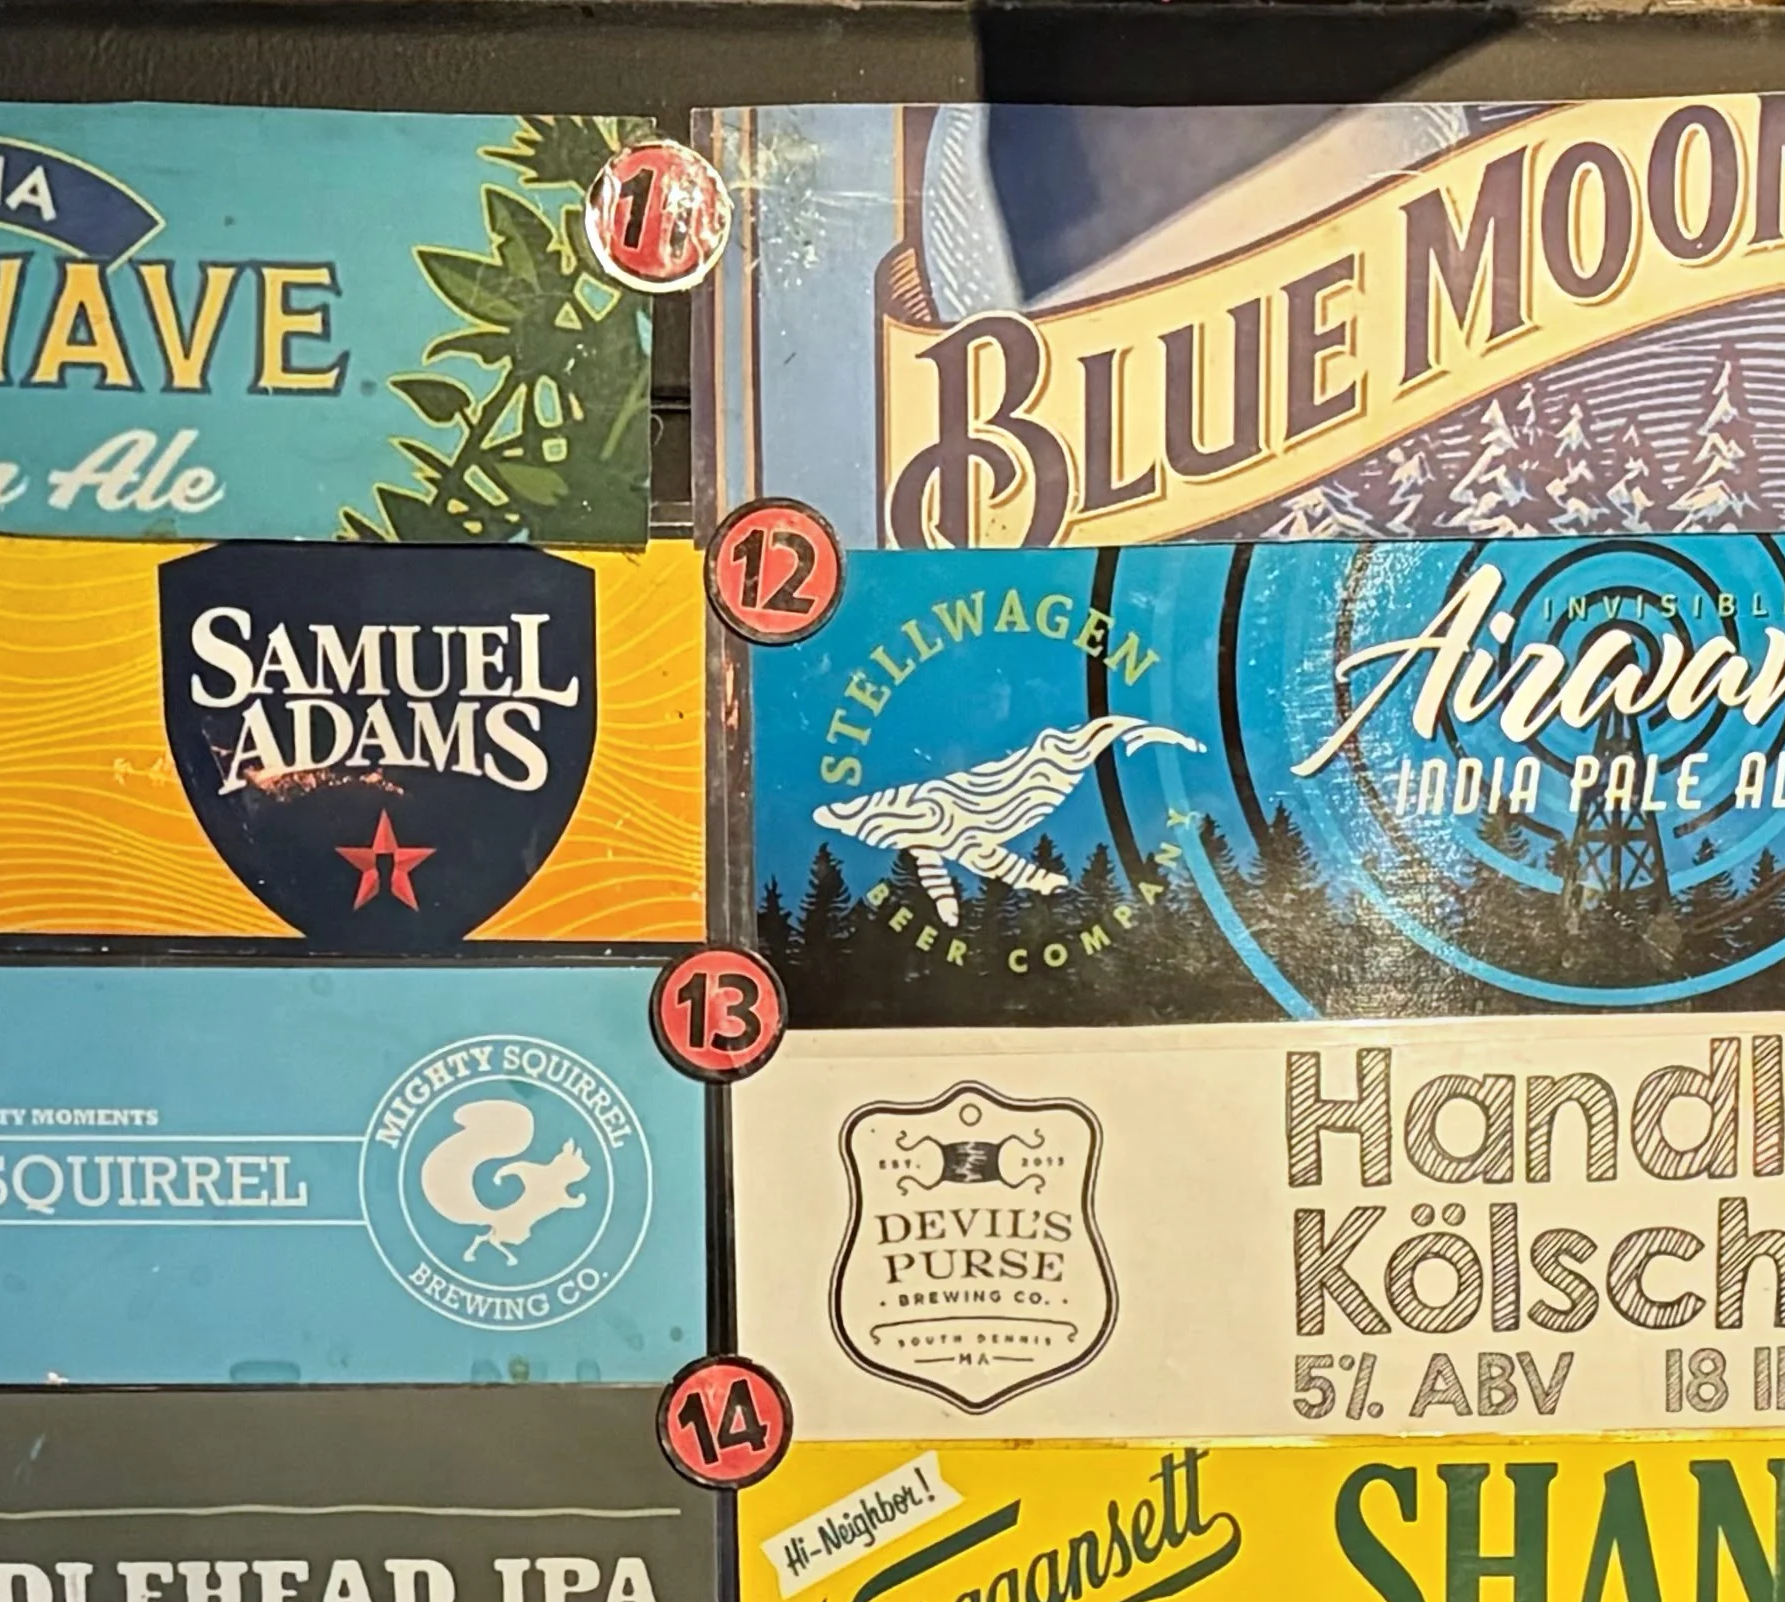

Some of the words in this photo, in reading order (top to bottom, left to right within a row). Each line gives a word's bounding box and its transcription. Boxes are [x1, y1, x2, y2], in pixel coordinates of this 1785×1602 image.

[889, 252, 1362, 549] BLUE
[45, 430, 227, 511] Ale
[729, 530, 823, 611] 12
[190, 607, 579, 709] SAMUEL
[818, 587, 1160, 786] STELLWAGEN
[218, 695, 549, 794] ADAMS
[1394, 761, 1540, 813] INDIA
[1570, 756, 1700, 813] PALE
[31, 1109, 159, 1126] MOMENTS
[875, 1208, 1074, 1248] DEVIL'S
[887, 1249, 1066, 1283] PURSE
[1294, 1353, 1384, 1420] 5%
[1408, 1351, 1577, 1419] ABV
[1665, 1347, 1730, 1413] 18
[781, 1463, 941, 1577] Hi-Neighbor!
